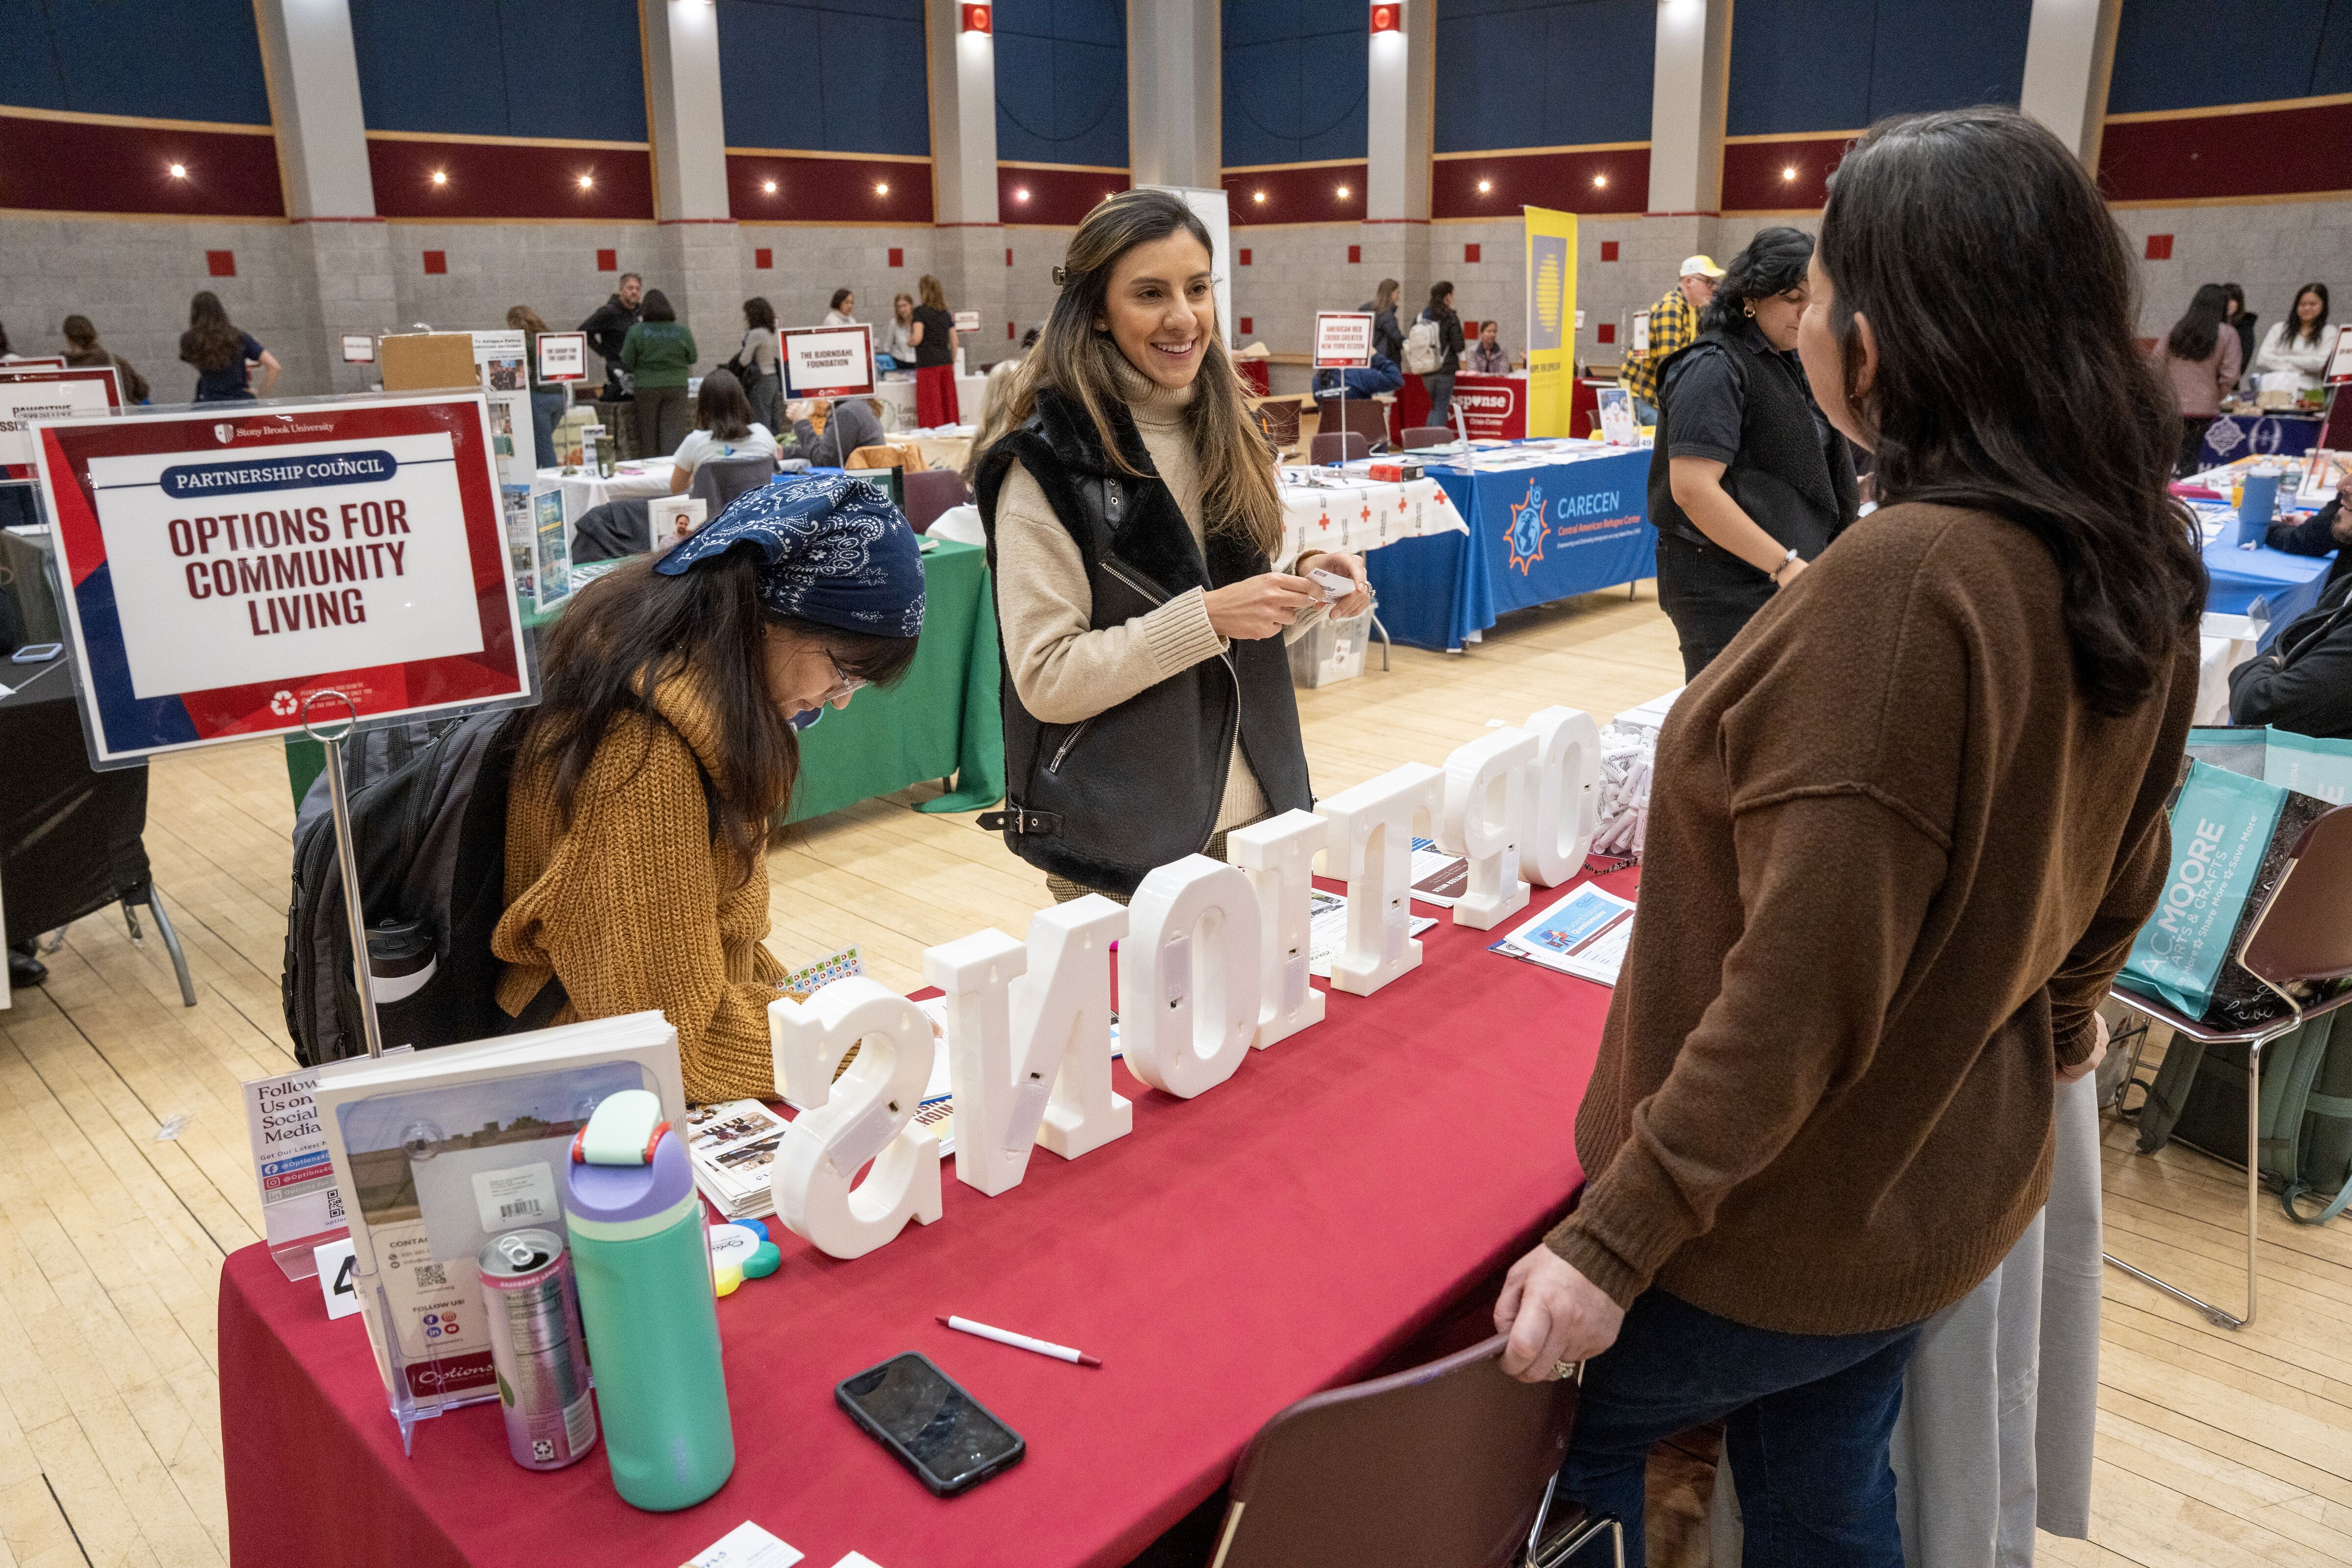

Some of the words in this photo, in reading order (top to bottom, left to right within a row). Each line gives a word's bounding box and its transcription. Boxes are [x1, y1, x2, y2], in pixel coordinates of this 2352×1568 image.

[807, 358, 849, 368] FOUNDATION
[814, 349, 854, 359] BJORNDAHL
[236, 427, 262, 438] Stony
[263, 424, 290, 435] Brook
[291, 422, 334, 433] University
[175, 465, 304, 490] PARTNERSHIP
[307, 459, 384, 478] COUNCIL
[1557, 490, 1620, 519] CARECEN
[168, 507, 331, 557] OPTIONS
[340, 499, 411, 539] FOR
[1558, 524, 1578, 536] Central
[1578, 522, 1603, 532] American
[1603, 518, 1623, 529] Refugee
[1623, 514, 1642, 525] Center
[185, 540, 405, 600] COMMUNITY
[247, 588, 367, 636] LIVING
[1609, 753, 1638, 761] Options
[1431, 882, 1450, 893] WEEK
[1575, 894, 1596, 908] Options
[2171, 926, 2193, 966] ARTS
[2187, 912, 2200, 923] &
[2194, 849, 2228, 909] CRAFTS
[2183, 949, 2199, 980] More
[2197, 907, 2217, 937] Share
[2210, 881, 2229, 906] More
[2228, 843, 2244, 868] Save
[1562, 900, 1608, 931] Student/Volunteer
[1571, 909, 1608, 935] Questionnaire
[257, 1079, 318, 1100] Follow
[260, 1101, 285, 1114] Us
[289, 1095, 314, 1108] on
[914, 1104, 954, 1126] NIGH
[262, 1105, 318, 1129] Social
[717, 1110, 746, 1124] SUPPORT
[265, 1123, 322, 1144] Media
[733, 1135, 763, 1149] HOUSING
[260, 1152, 275, 1161] Get
[294, 1142, 319, 1152] Latest
[284, 1182, 316, 1196] Options
[499, 1277, 539, 1288] RASPBERRY
[413, 1299, 449, 1313] FOLLOW
[418, 1364, 493, 1386] Options
